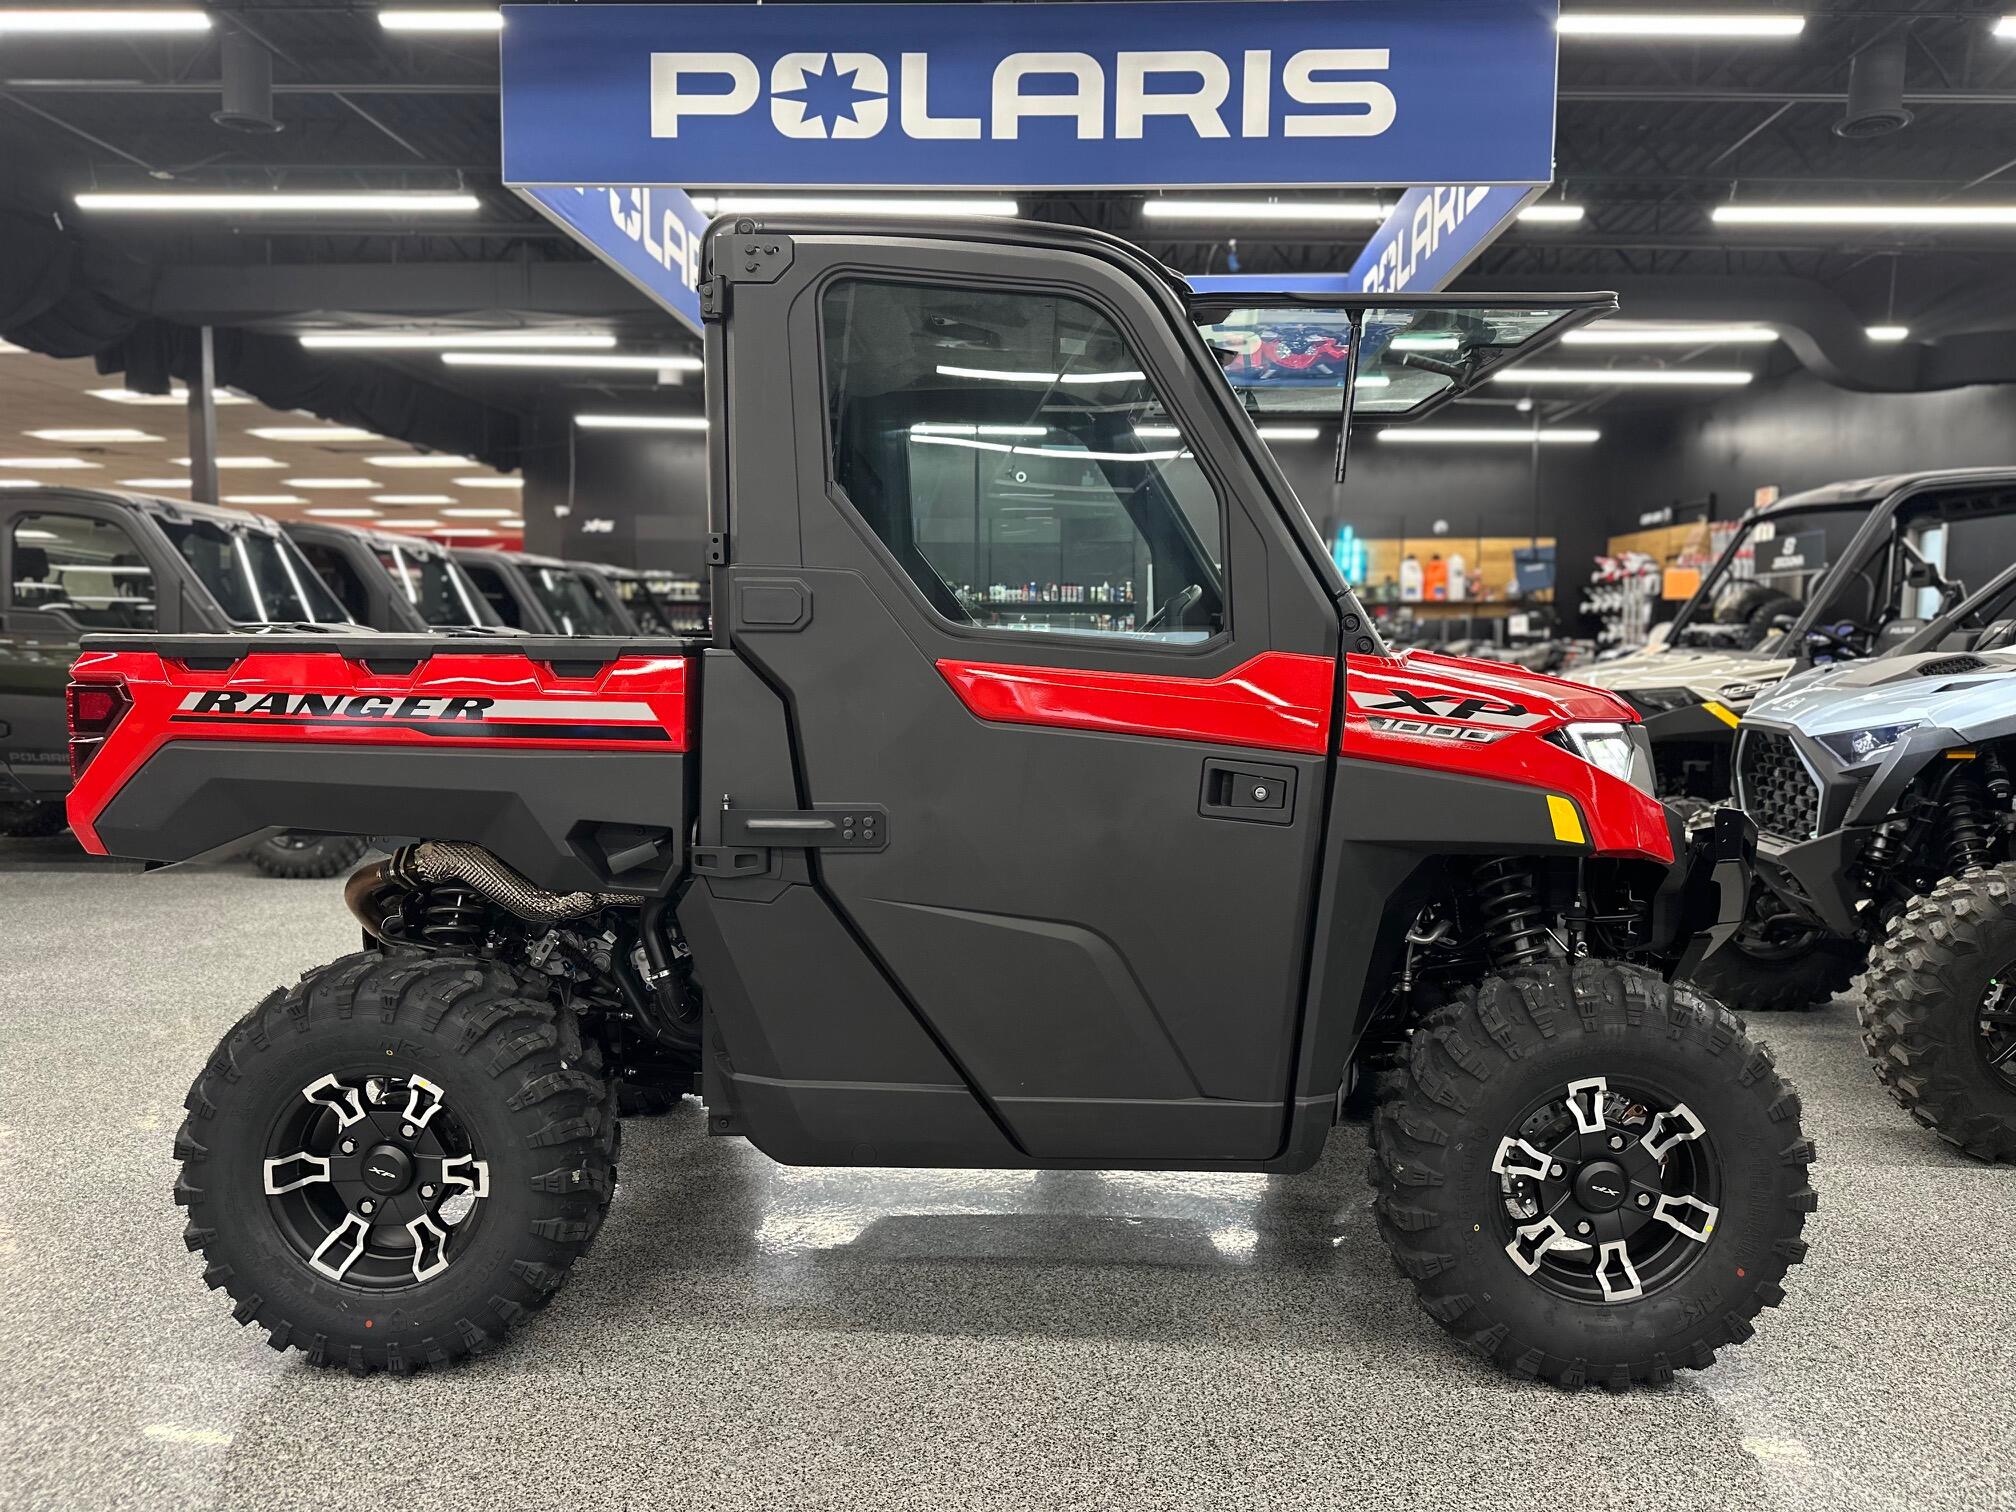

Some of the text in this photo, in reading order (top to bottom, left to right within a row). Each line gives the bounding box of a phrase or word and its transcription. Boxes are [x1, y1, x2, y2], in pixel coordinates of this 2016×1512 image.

[650, 48, 1397, 139] POLARIS
[193, 690, 495, 720] RANGER
[1363, 689, 1529, 719] XP
[1380, 718, 1495, 743] 1000
[368, 1166, 396, 1179] XP
[1591, 1185, 1620, 1197] XP
